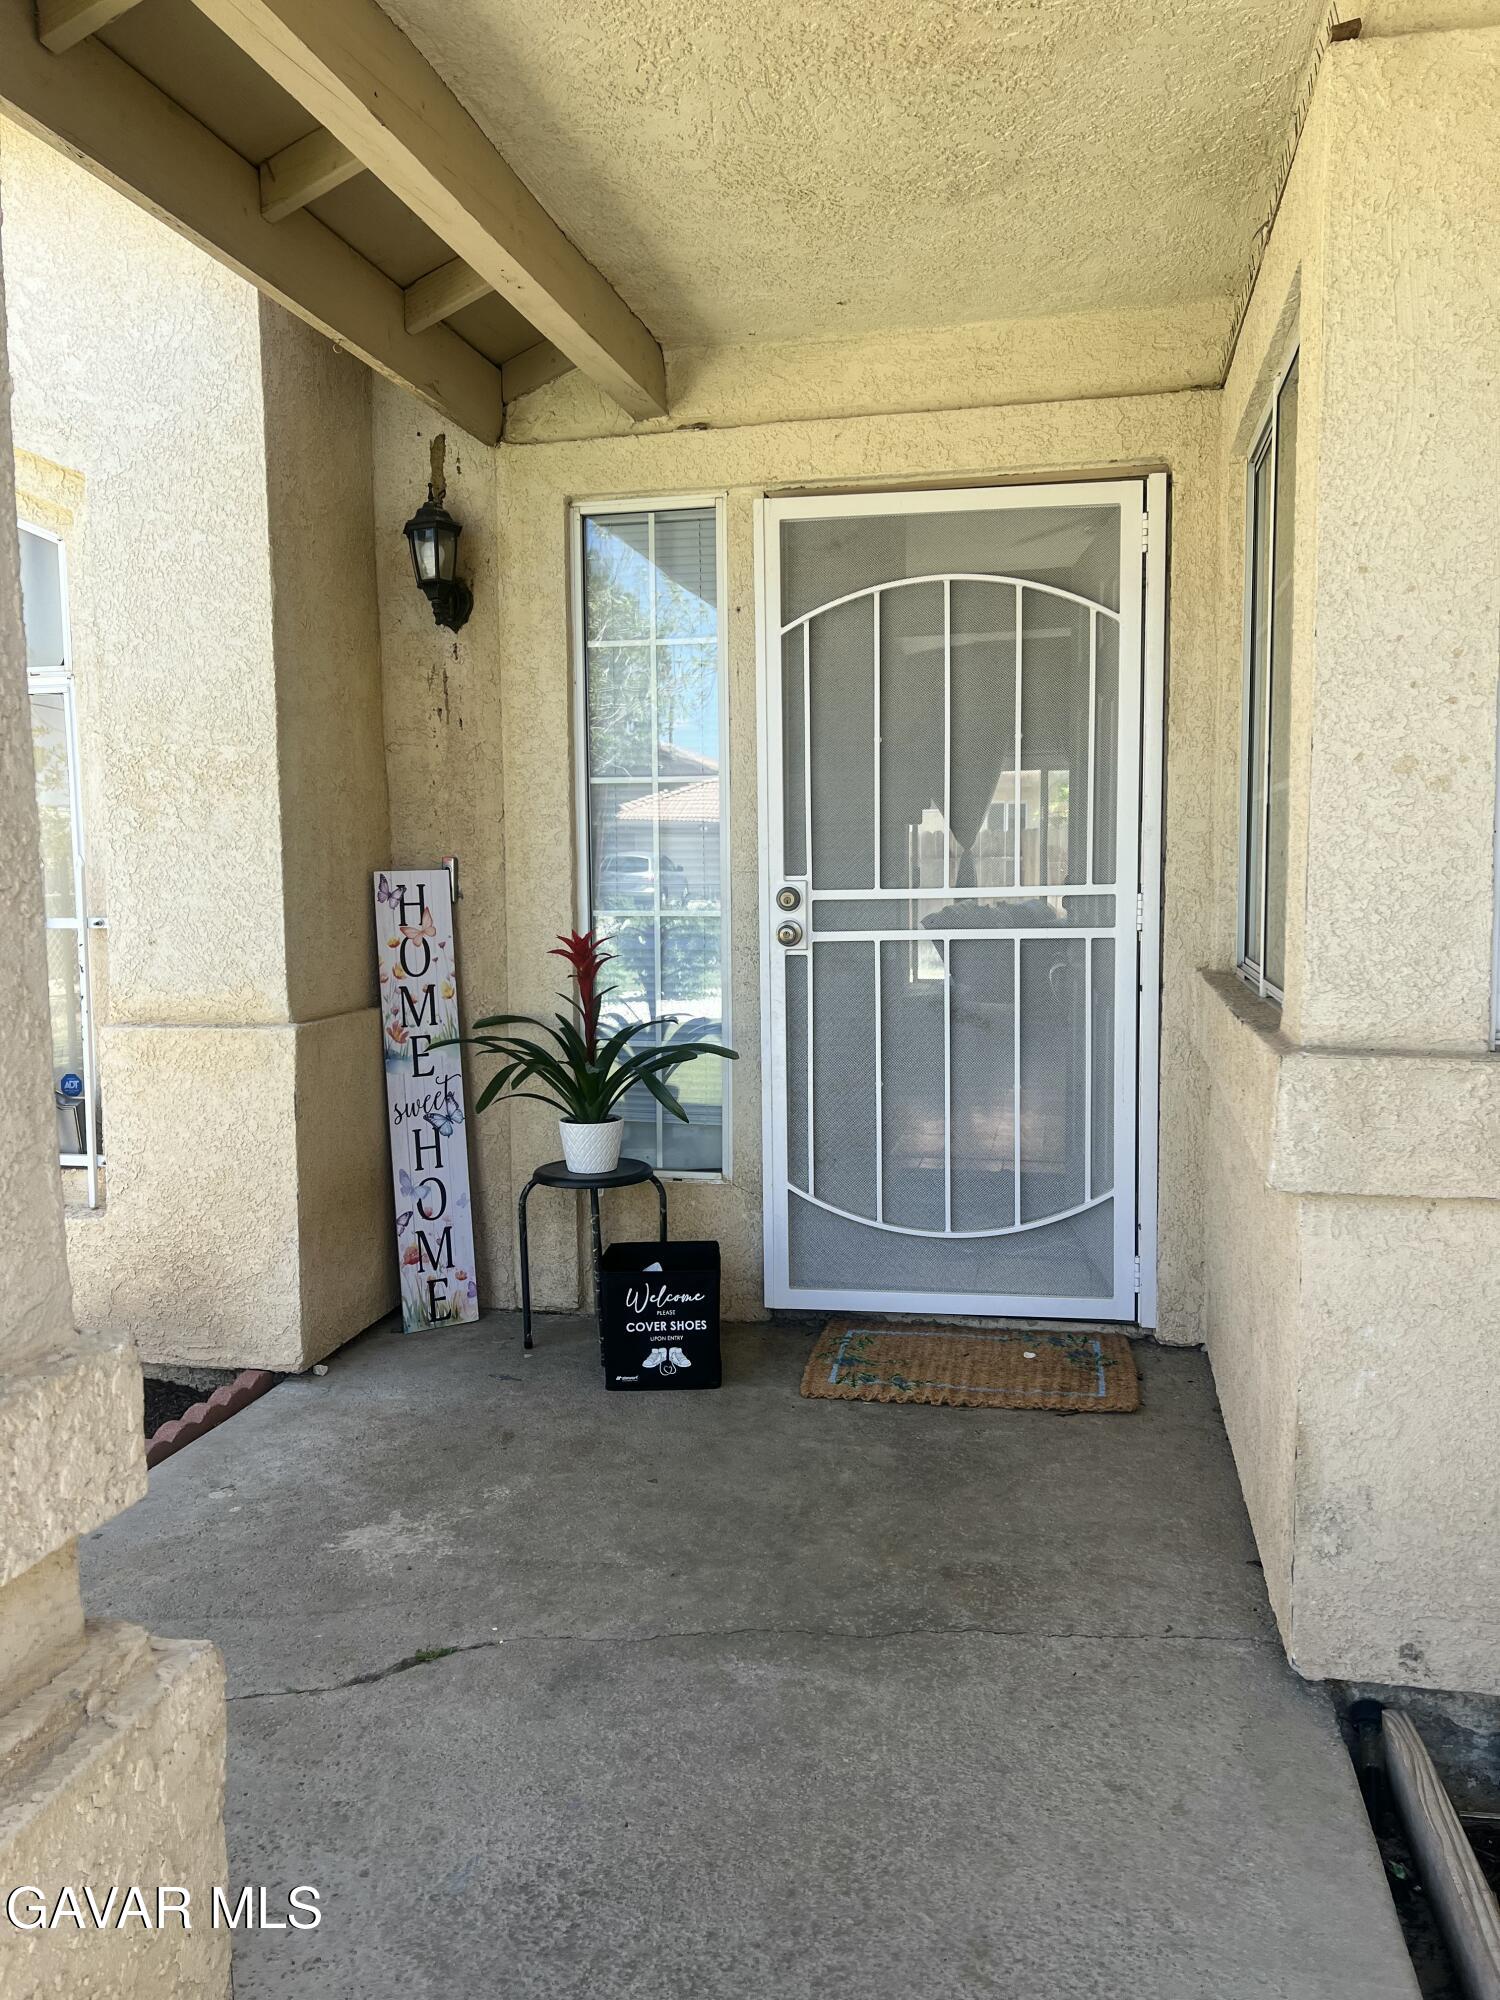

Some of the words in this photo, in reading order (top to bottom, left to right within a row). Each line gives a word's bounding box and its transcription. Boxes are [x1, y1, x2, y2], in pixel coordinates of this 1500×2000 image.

[396, 884, 439, 1077] HOME
[64, 1080, 80, 1089] ADT
[394, 1073, 461, 1125] sweet
[412, 1127, 455, 1322] HOME
[625, 1282, 706, 1313] Welcome
[625, 1321, 667, 1333] COVER
[670, 1320, 708, 1331] SHOES
